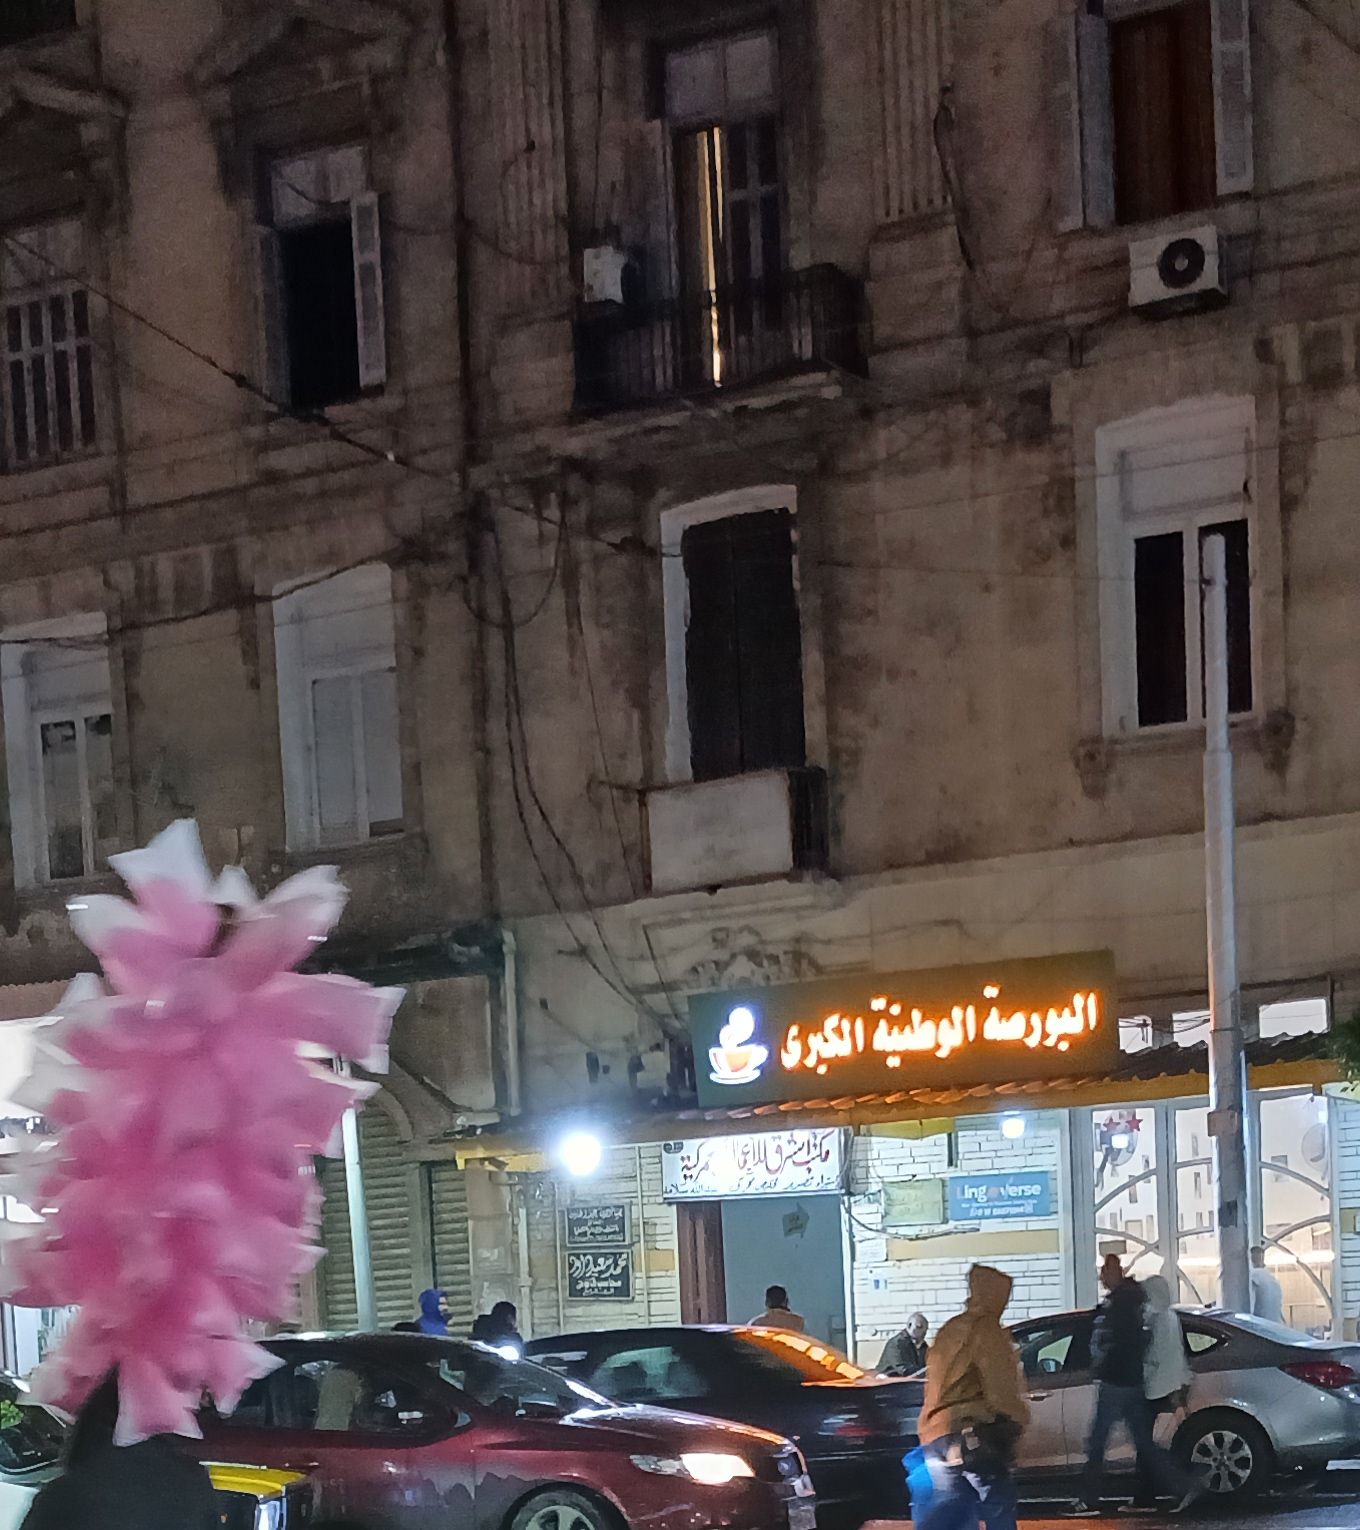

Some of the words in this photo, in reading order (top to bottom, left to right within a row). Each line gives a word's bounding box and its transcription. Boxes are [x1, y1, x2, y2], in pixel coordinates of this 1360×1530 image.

[780, 1013, 865, 1075] الكبرى
[870, 994, 976, 1068] الوطنية
[983, 984, 1098, 1051] البورصة
